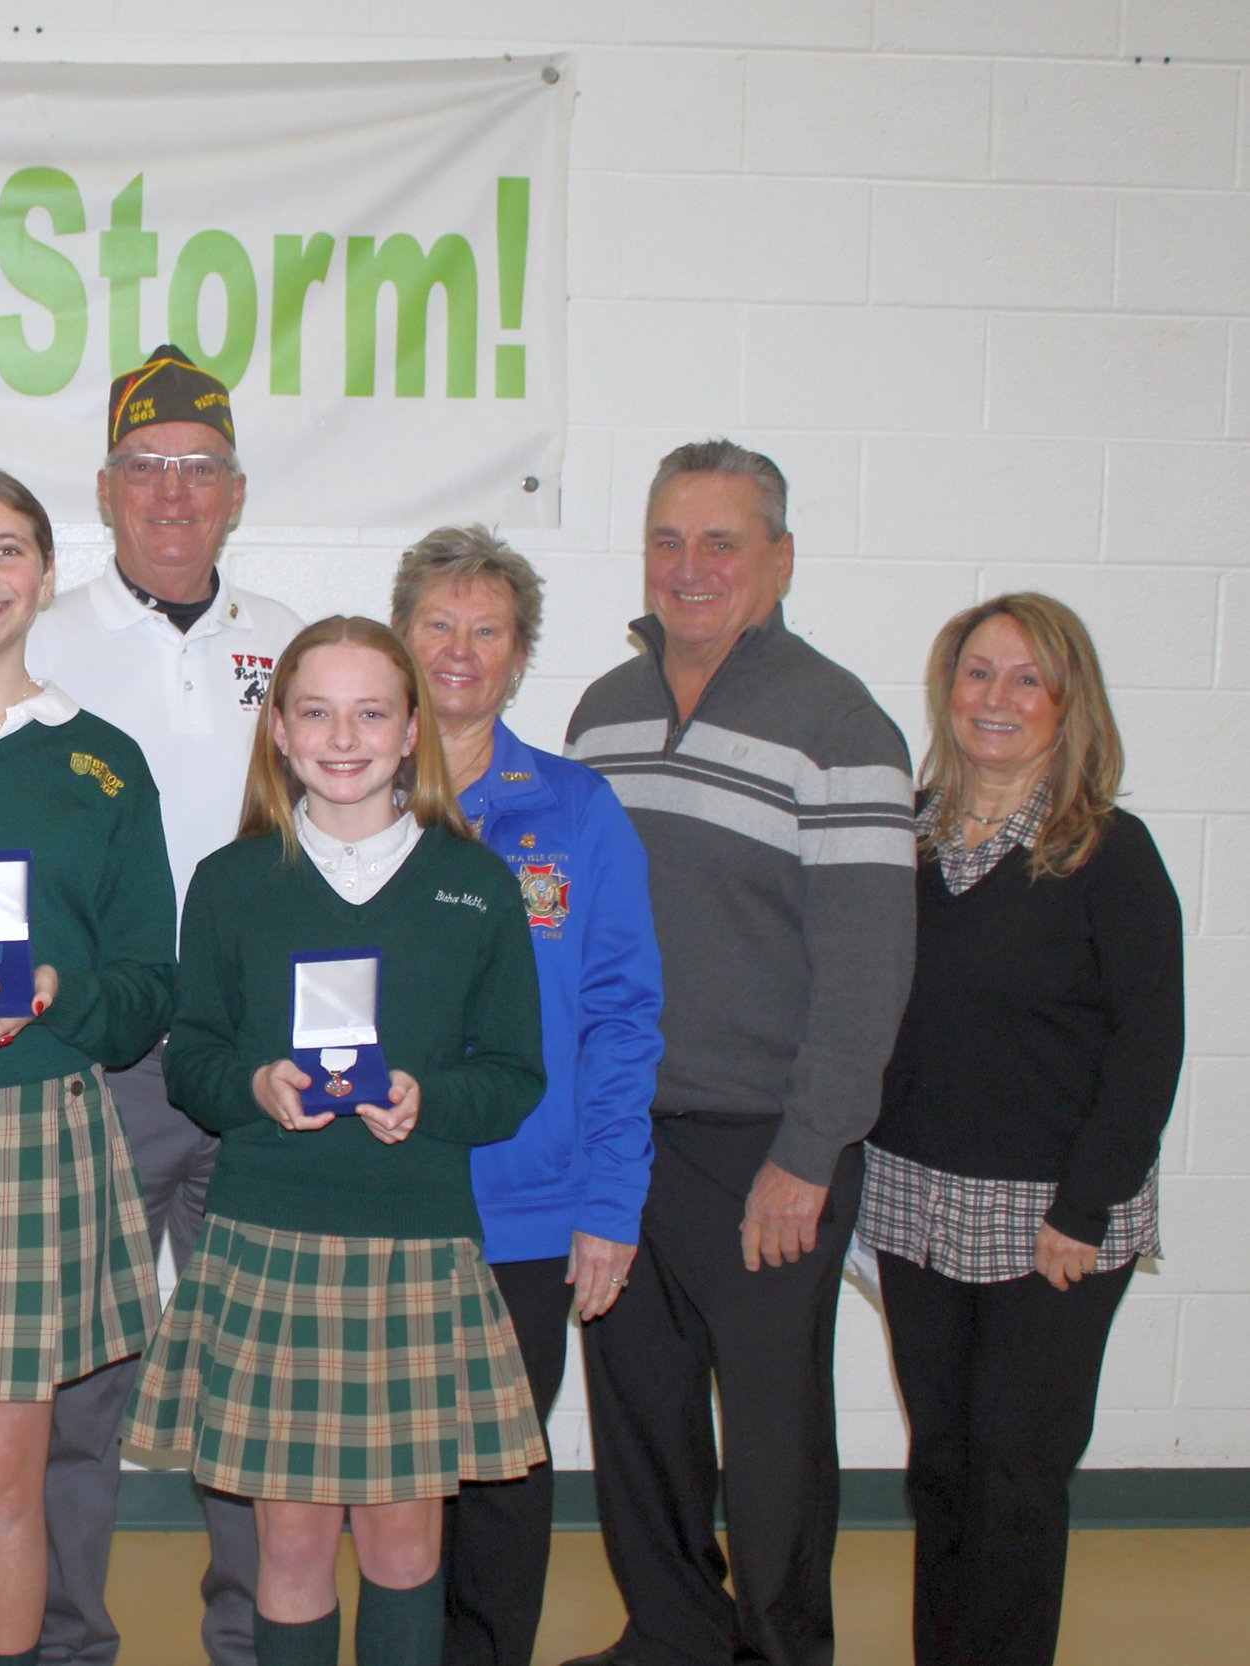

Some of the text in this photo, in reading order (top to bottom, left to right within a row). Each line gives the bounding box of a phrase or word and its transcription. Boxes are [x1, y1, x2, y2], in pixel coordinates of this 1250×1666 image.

[129, 398, 154, 413] VFW
[231, 654, 273, 670] VFW
[234, 667, 258, 680] Post
